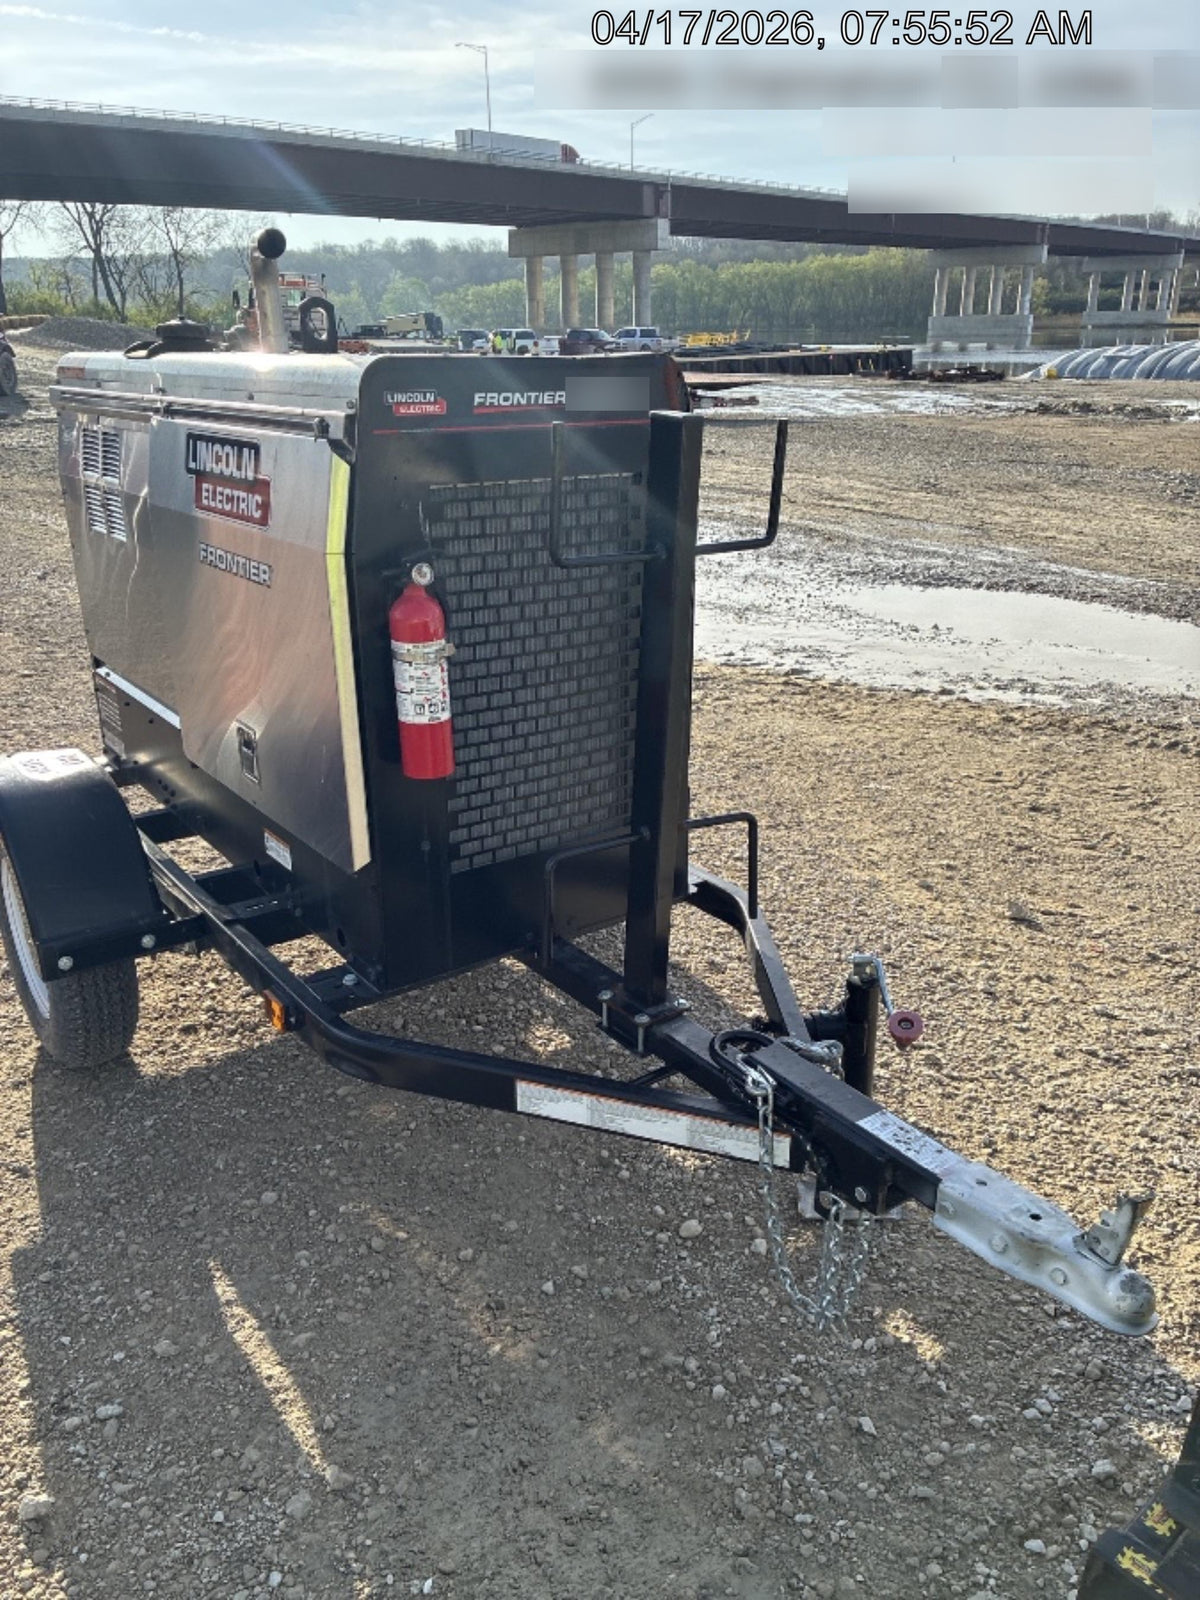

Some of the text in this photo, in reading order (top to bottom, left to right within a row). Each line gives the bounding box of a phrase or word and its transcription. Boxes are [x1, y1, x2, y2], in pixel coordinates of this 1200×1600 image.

[386, 391, 435, 403] LINCOLN
[399, 404, 442, 414] ELECTRIC
[474, 391, 566, 406] FRONTIER
[188, 438, 256, 481] LINCOLN
[202, 483, 262, 519] ELECTRIC
[199, 543, 272, 588] FRONTIER
